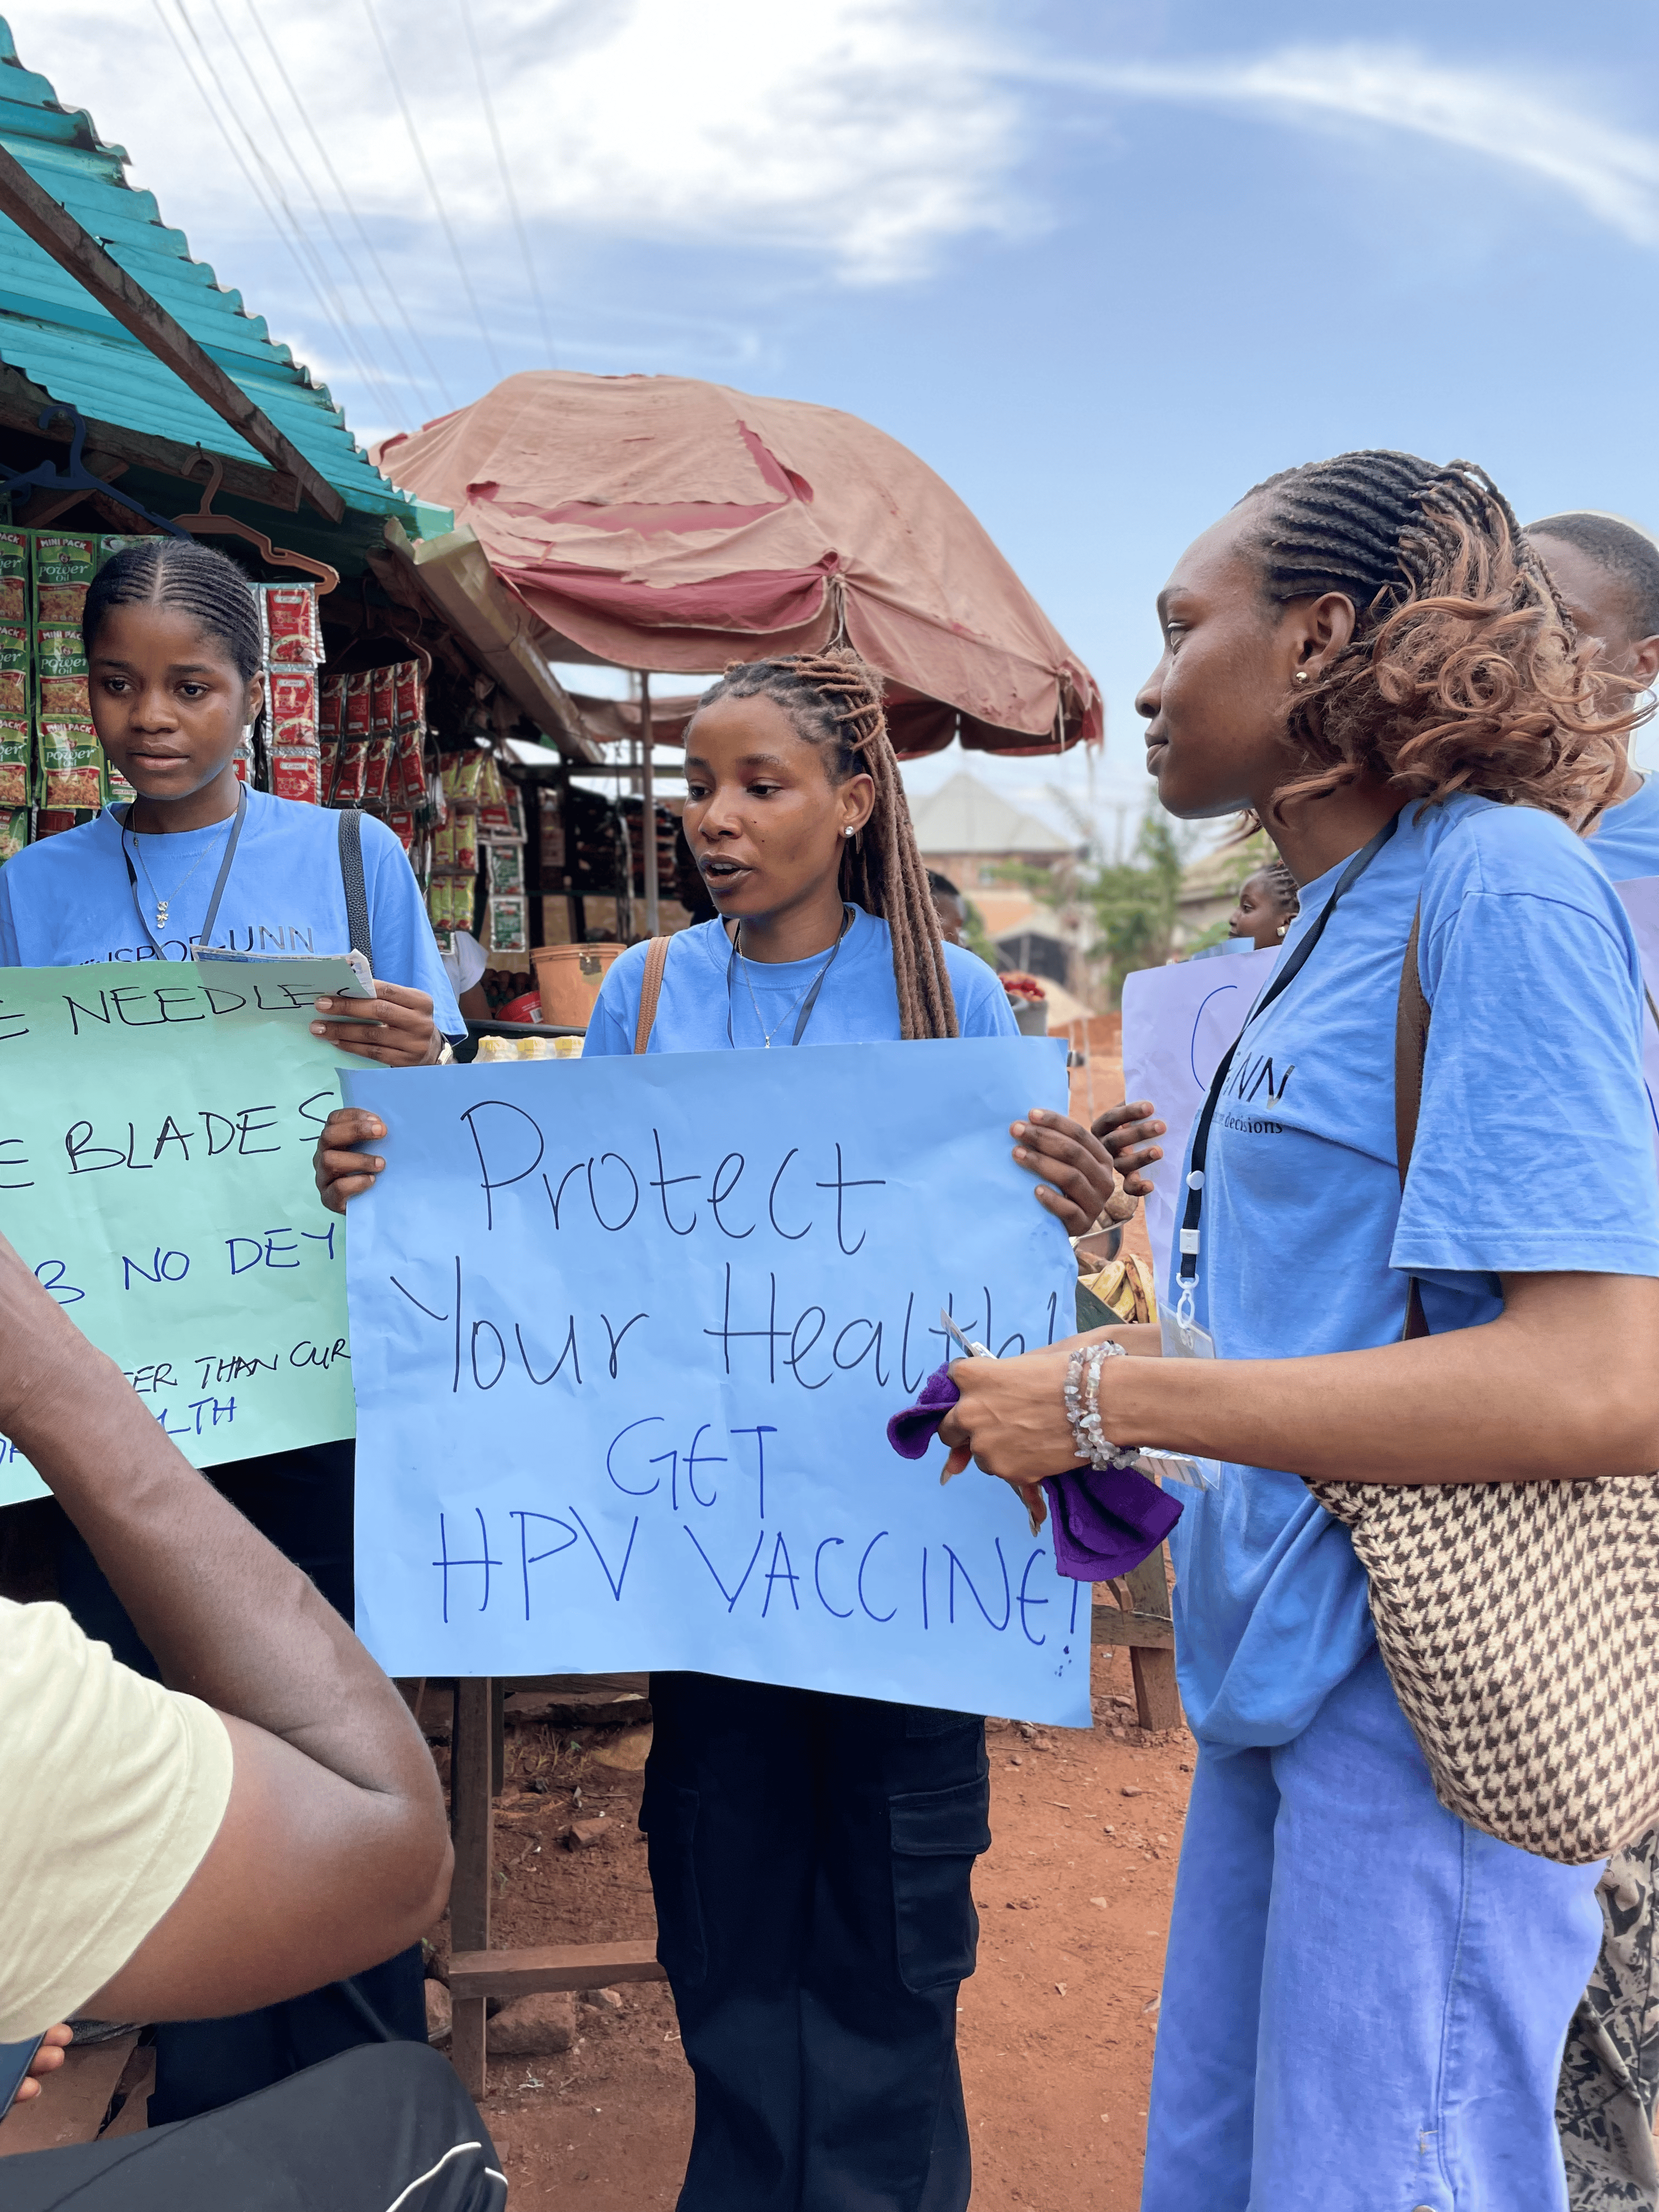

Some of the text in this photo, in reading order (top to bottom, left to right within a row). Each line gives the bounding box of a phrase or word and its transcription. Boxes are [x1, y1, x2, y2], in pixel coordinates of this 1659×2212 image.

[40, 538, 87, 550] MINI PACK
[42, 630, 84, 641] MINI PAC
[46, 723, 92, 734] MINI PACK
[229, 925, 314, 953] UNN
[1223, 1051, 1296, 1110] NN
[65, 1091, 335, 1175] BLADES
[1224, 1111, 1283, 1135] decisions
[461, 1100, 887, 1255] Protect
[122, 1246, 190, 1290] NO
[224, 1222, 335, 1276] DEY
[390, 1255, 650, 1393] Your
[123, 1362, 178, 1393] ER
[194, 1353, 278, 1390] THAN
[606, 1417, 777, 1519] GET
[432, 1505, 1079, 1656] HPV VACCINE!
